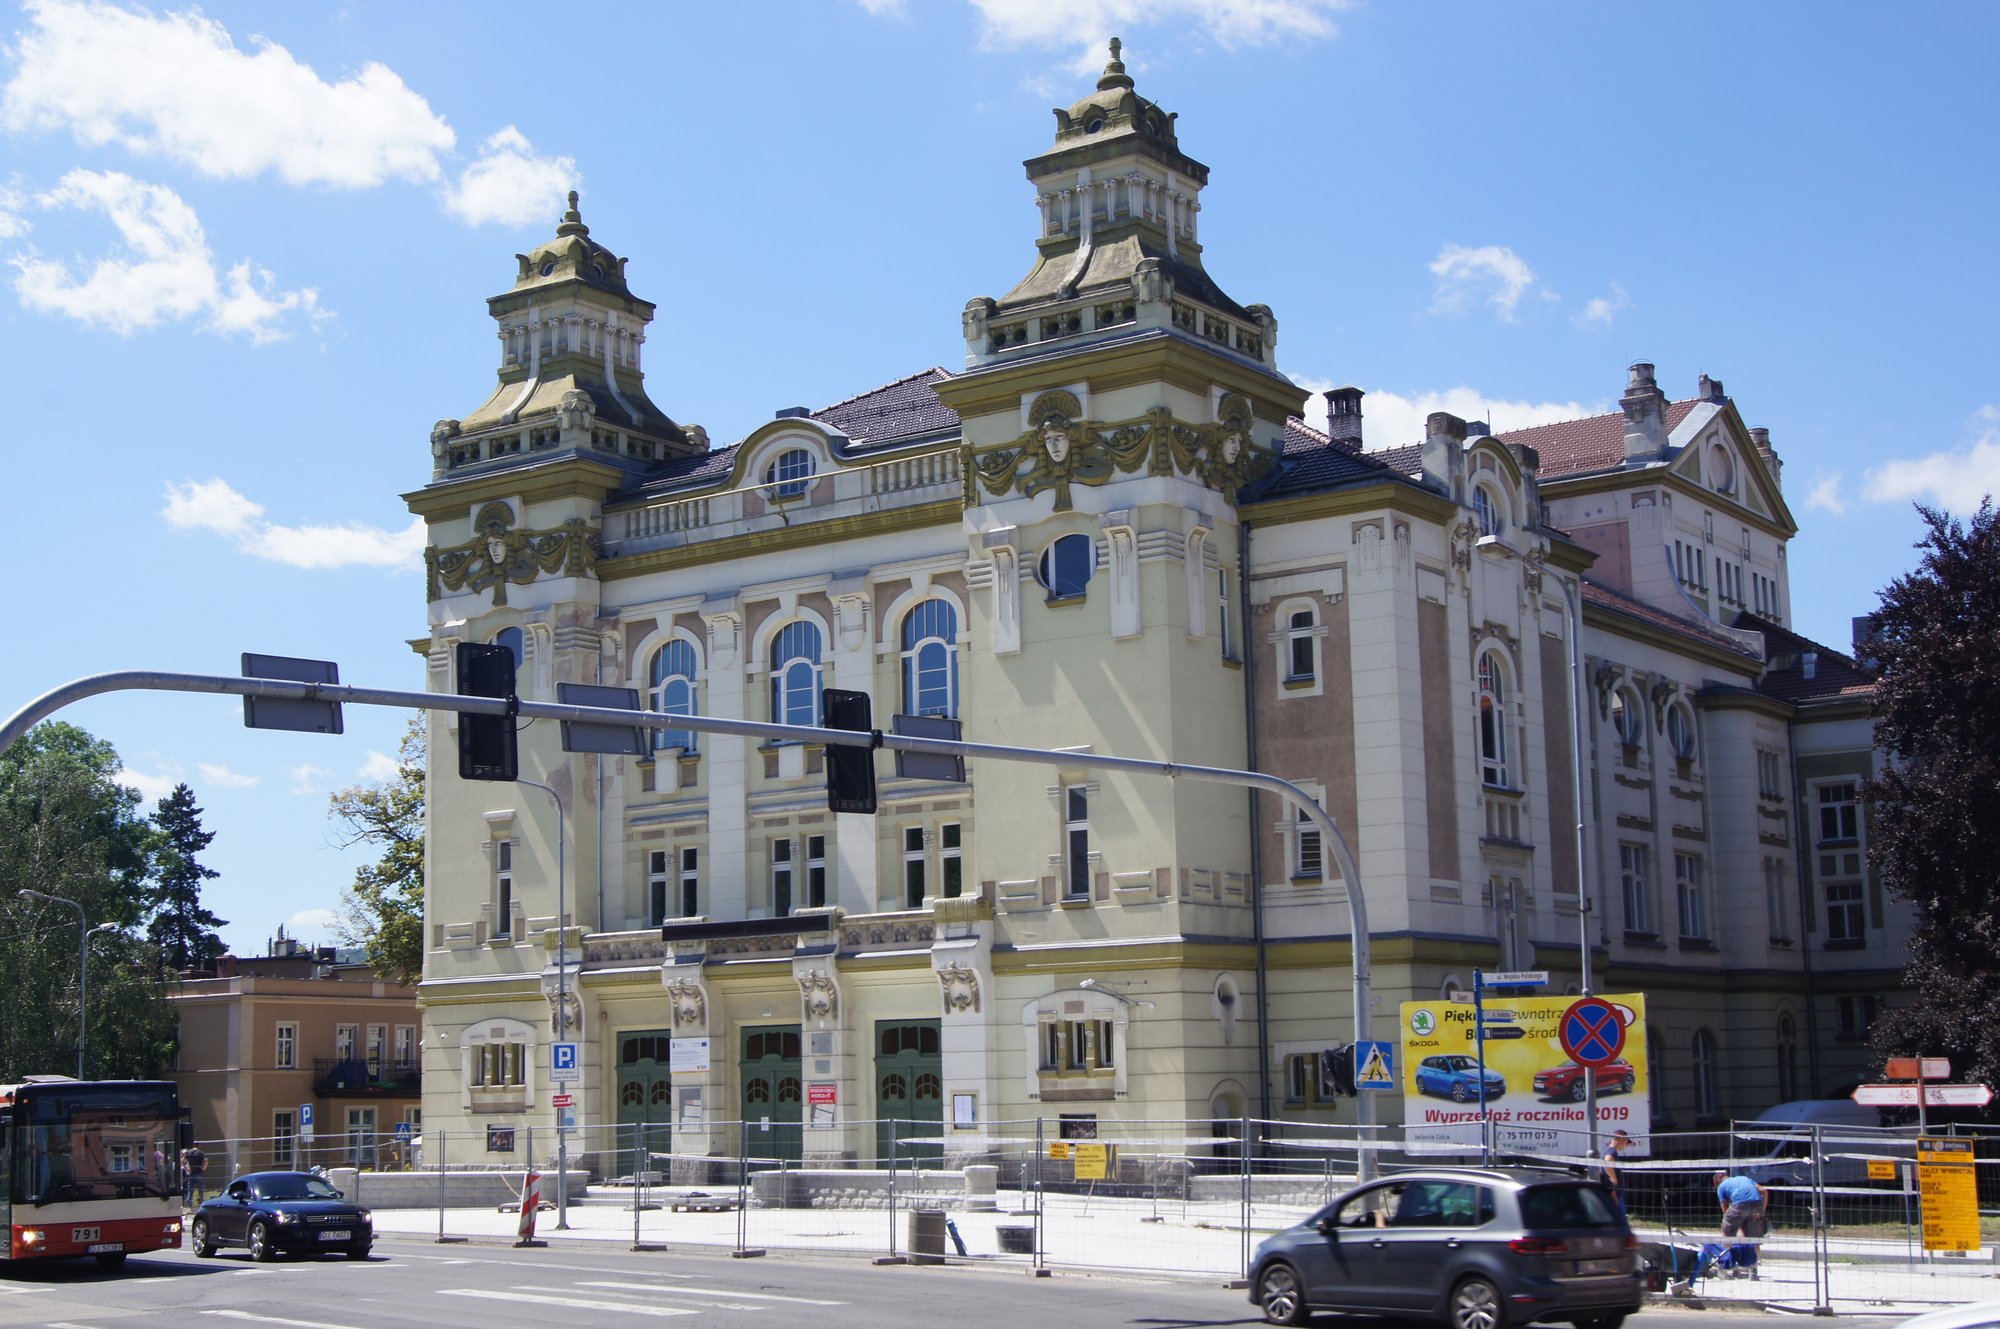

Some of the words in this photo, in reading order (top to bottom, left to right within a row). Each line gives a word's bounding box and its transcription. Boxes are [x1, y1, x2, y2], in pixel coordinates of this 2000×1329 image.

[1512, 1008, 1564, 1024] ewnątrz
[1528, 1027, 1560, 1038] środ
[558, 1047, 571, 1066] P
[303, 1106, 310, 1123] P
[1425, 1108, 1511, 1125] Wyprzedaż
[1516, 1107, 1585, 1121] rocznika
[74, 1228, 99, 1240] 791
